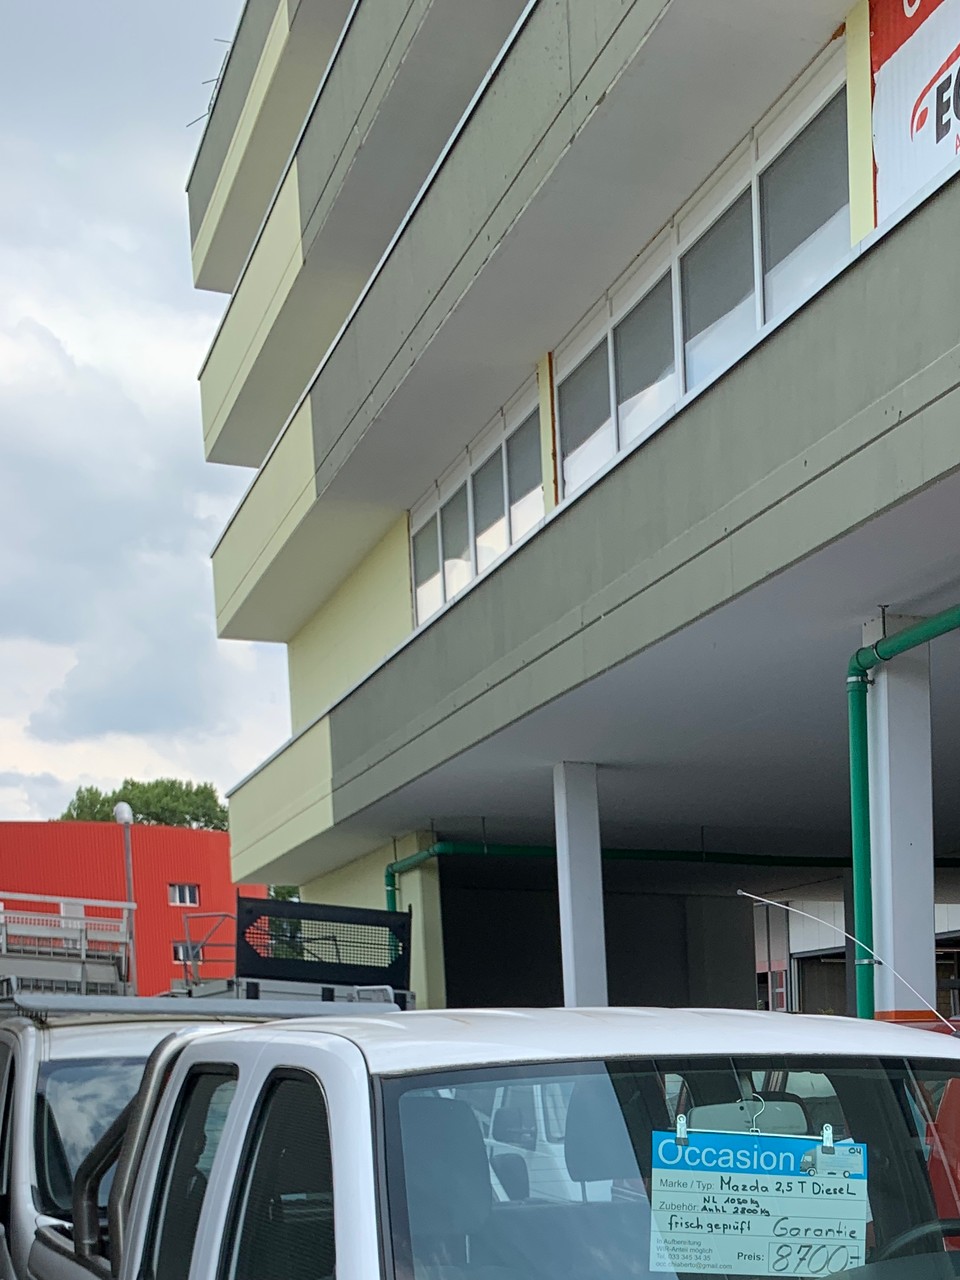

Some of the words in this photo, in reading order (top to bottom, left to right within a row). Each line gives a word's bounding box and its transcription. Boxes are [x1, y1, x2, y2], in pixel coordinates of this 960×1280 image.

[657, 1138, 795, 1172] Occasion
[660, 1178, 688, 1189] Marke
[696, 1180, 715, 1191] Typ:
[720, 1175, 770, 1193] Mazda
[775, 1181, 793, 1194] 2,5
[798, 1181, 807, 1193] T
[659, 1200, 699, 1211] Zubehör:
[772, 1216, 857, 1239] Garantie
[737, 1251, 765, 1261] Preis:
